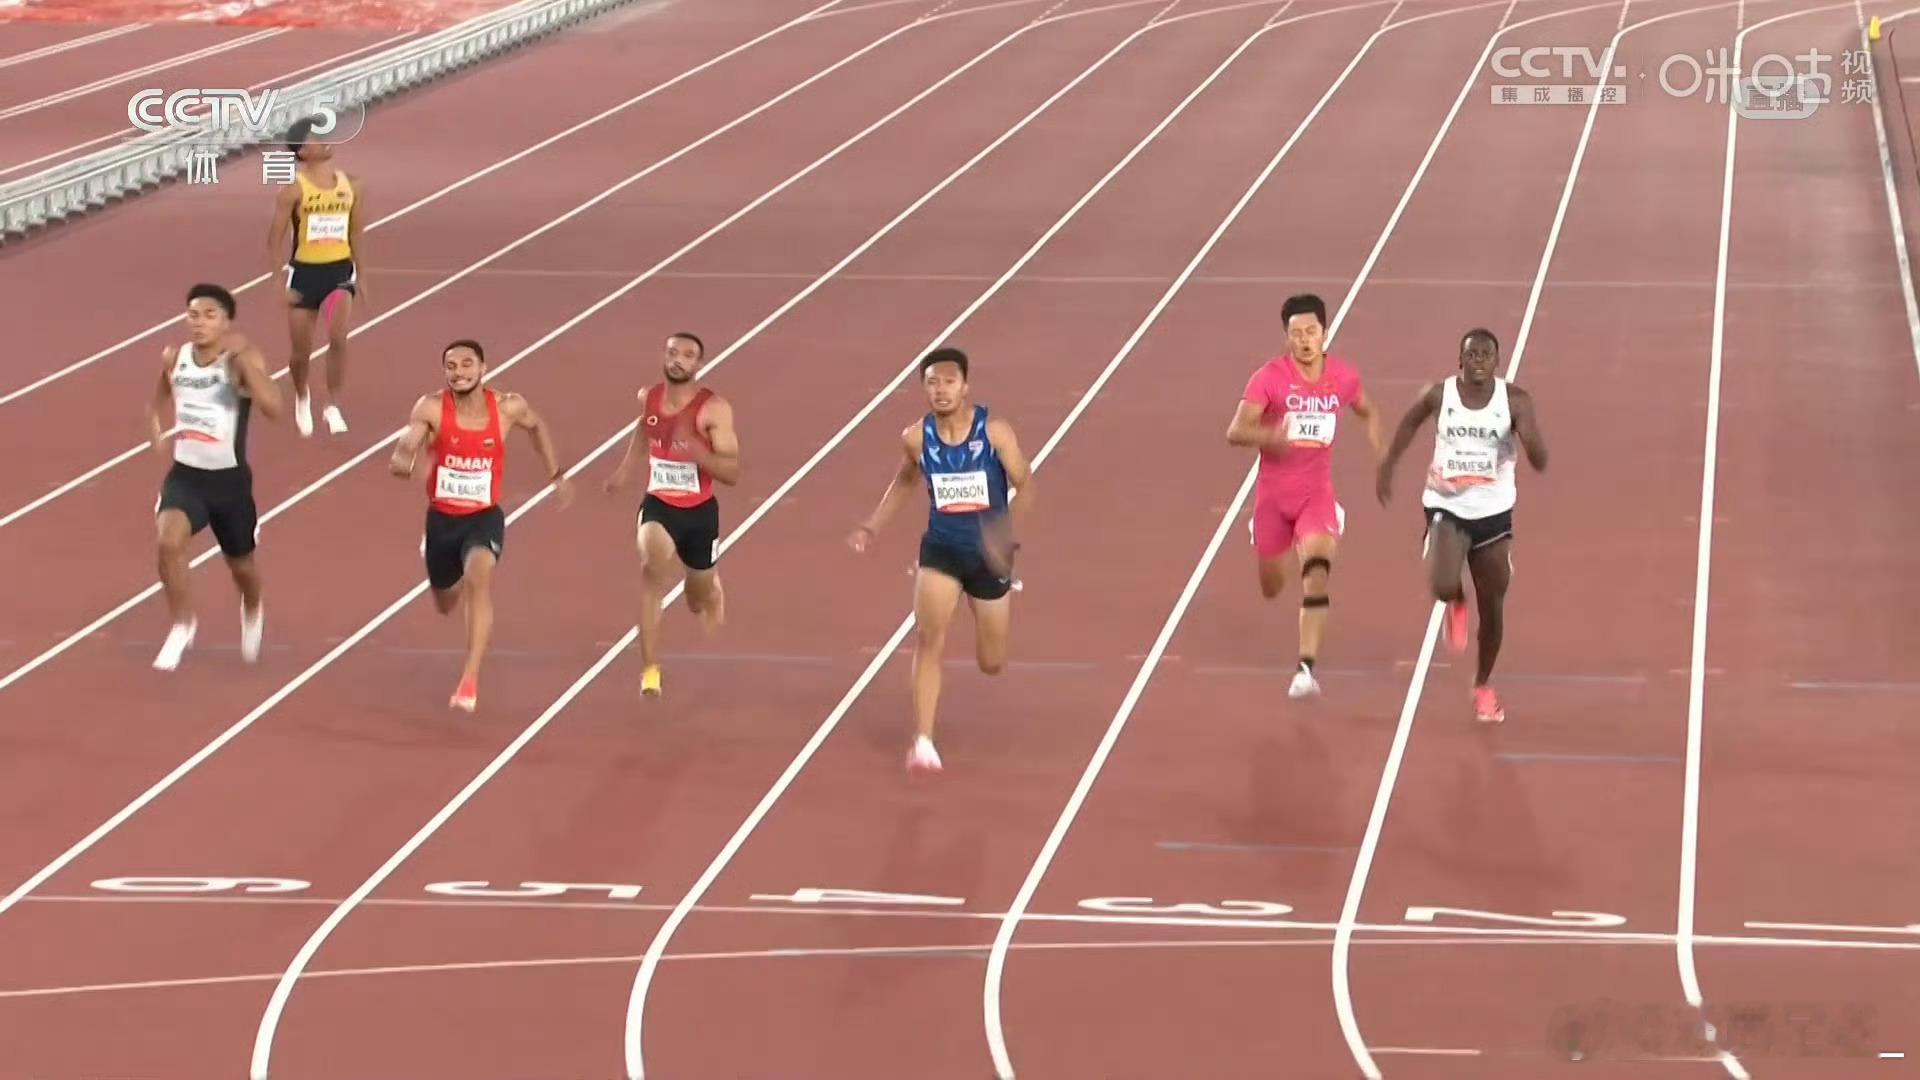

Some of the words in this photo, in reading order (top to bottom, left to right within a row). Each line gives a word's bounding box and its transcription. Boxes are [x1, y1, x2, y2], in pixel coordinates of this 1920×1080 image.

[1285, 393, 1340, 412] CHINA
[1298, 423, 1321, 437] XIE
[1446, 426, 1500, 439] KOREA
[445, 454, 494, 471] OMAN
